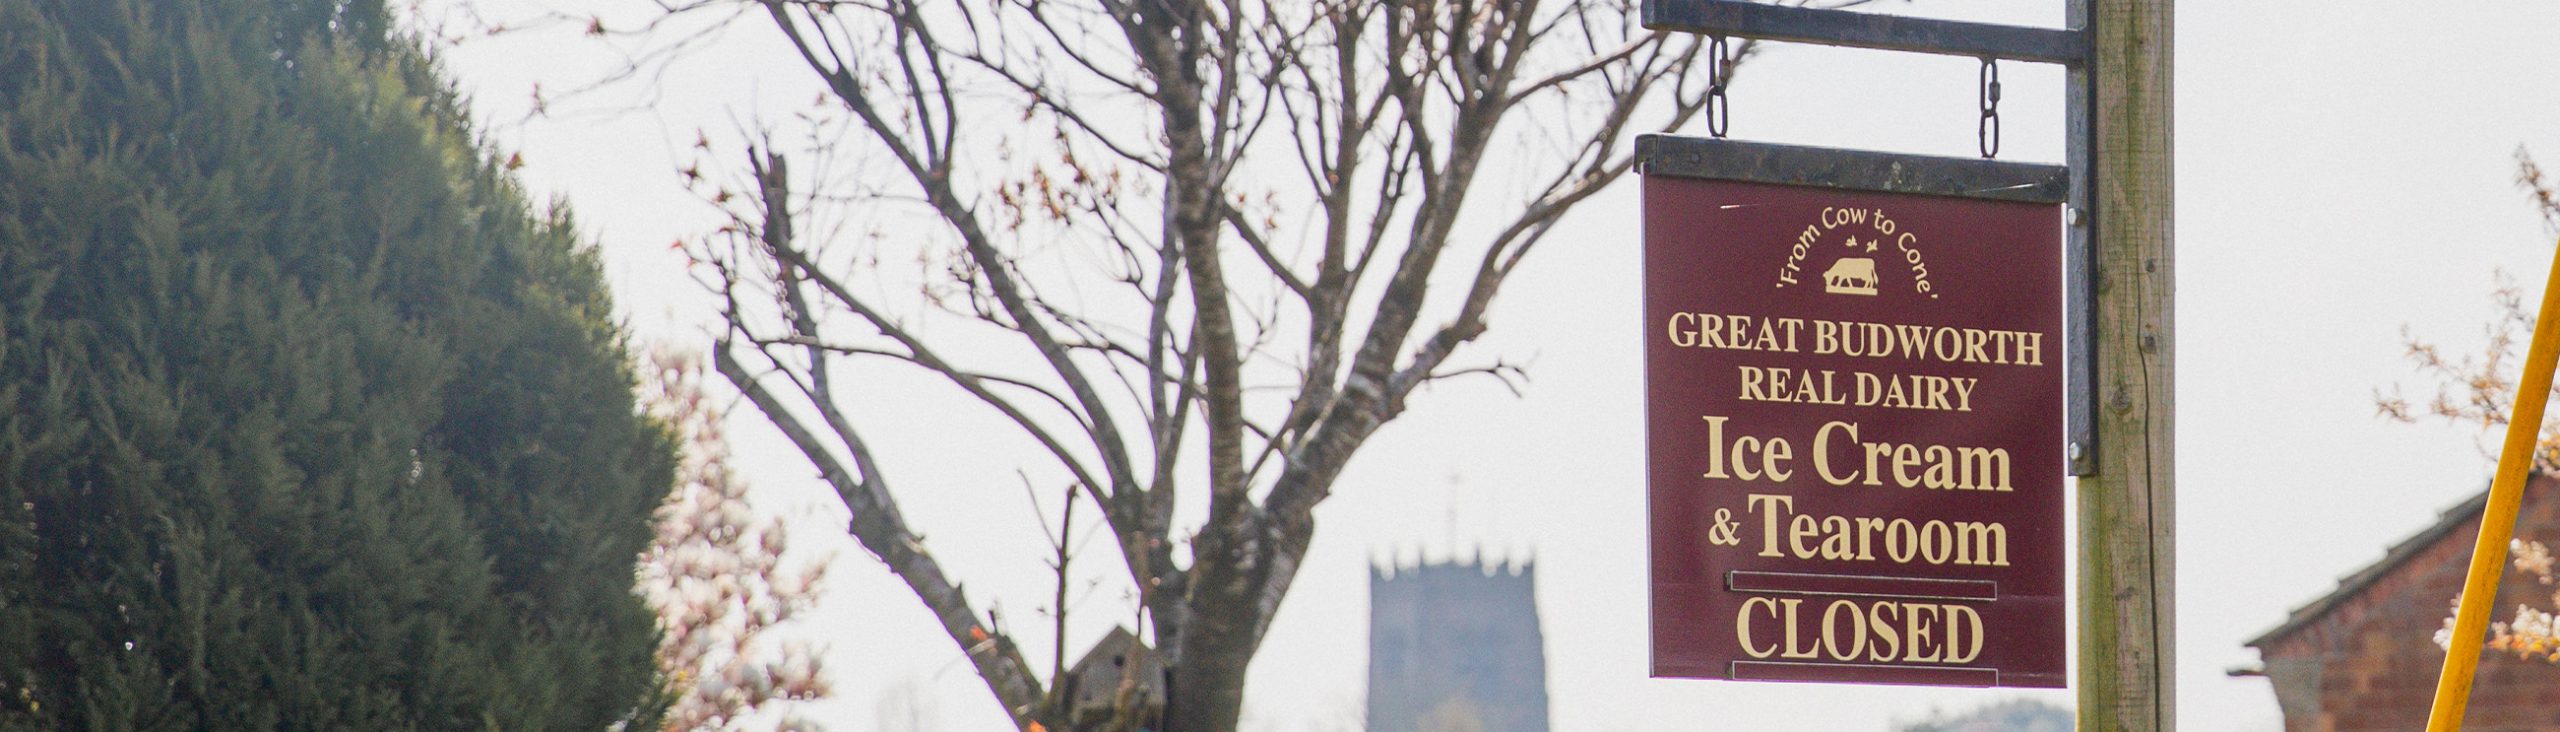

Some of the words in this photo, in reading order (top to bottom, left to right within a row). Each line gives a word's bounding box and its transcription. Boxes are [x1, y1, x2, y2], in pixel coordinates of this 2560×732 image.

[1775, 224, 1821, 288] 'From
[1821, 206, 1868, 230] Cow
[1873, 208, 1896, 235] to
[1897, 232, 1938, 299] Cone'
[1668, 311, 1804, 353] GREAT
[1813, 319, 2043, 366] BUDWORTH
[1738, 365, 1847, 405] REAL
[1854, 371, 1978, 412] DAIRY
[1702, 415, 1793, 483] Ice
[1812, 420, 2014, 492] Cream
[1708, 507, 1741, 546] &
[1748, 493, 2010, 566] Tearoom
[1736, 596, 1984, 664] CLOSED
